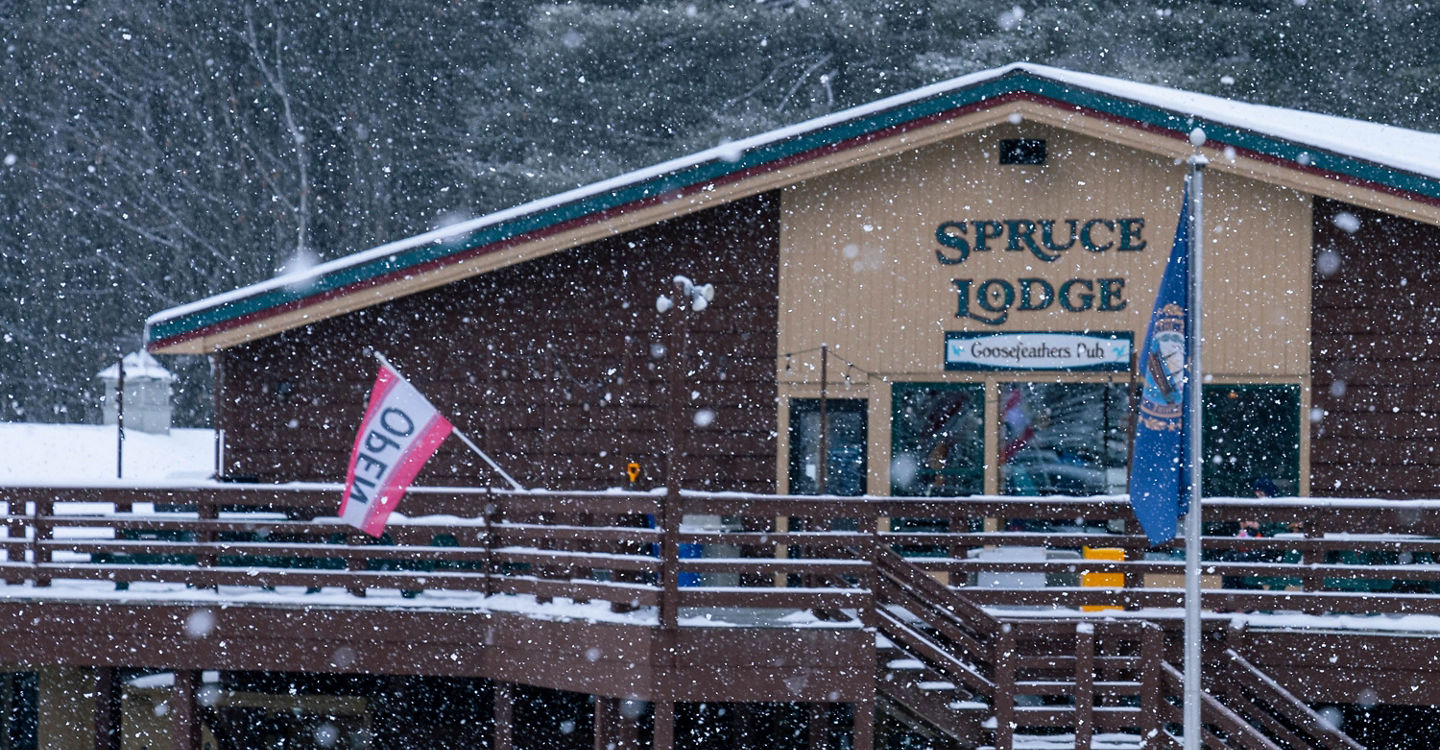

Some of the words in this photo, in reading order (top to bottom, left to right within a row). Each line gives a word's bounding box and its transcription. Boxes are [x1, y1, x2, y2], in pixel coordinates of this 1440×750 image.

[935, 218, 1147, 265] SPRUCE
[951, 277, 1128, 325] LODGE
[970, 341, 1071, 362] Goosefeathers
[1077, 340, 1104, 359] Pub
